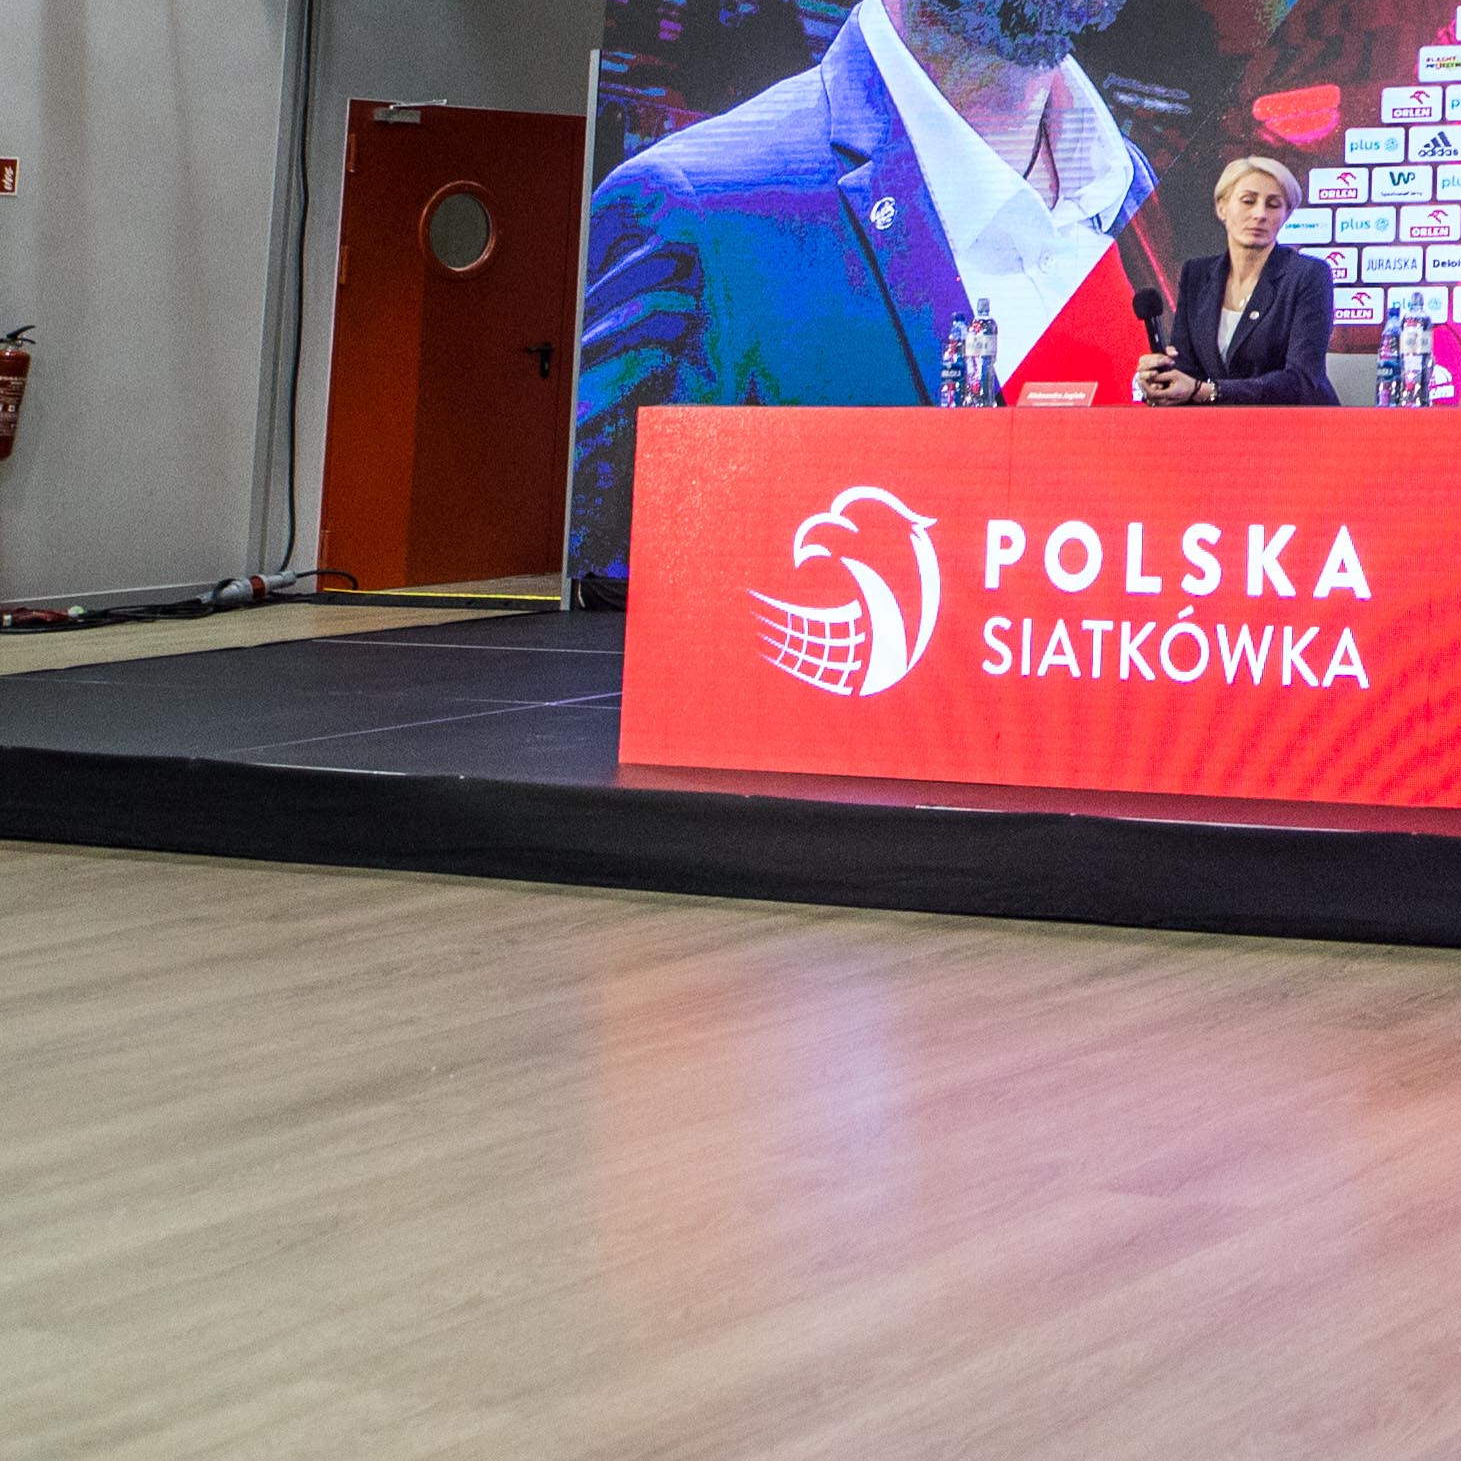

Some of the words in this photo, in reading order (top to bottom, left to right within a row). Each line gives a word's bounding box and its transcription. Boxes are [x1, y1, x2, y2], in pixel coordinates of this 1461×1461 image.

[1392, 107, 1432, 117] ORLEN
[1350, 138, 1380, 153] plus
[1418, 146, 1458, 157] adidas
[1319, 189, 1357, 199] ORLEN
[1341, 216, 1376, 232] plus
[1410, 226, 1449, 237] ORLEN
[1367, 257, 1418, 271] JURAJSKA
[984, 519, 1372, 599] POLSKA
[982, 605, 1369, 689] SIATKÓWKA
